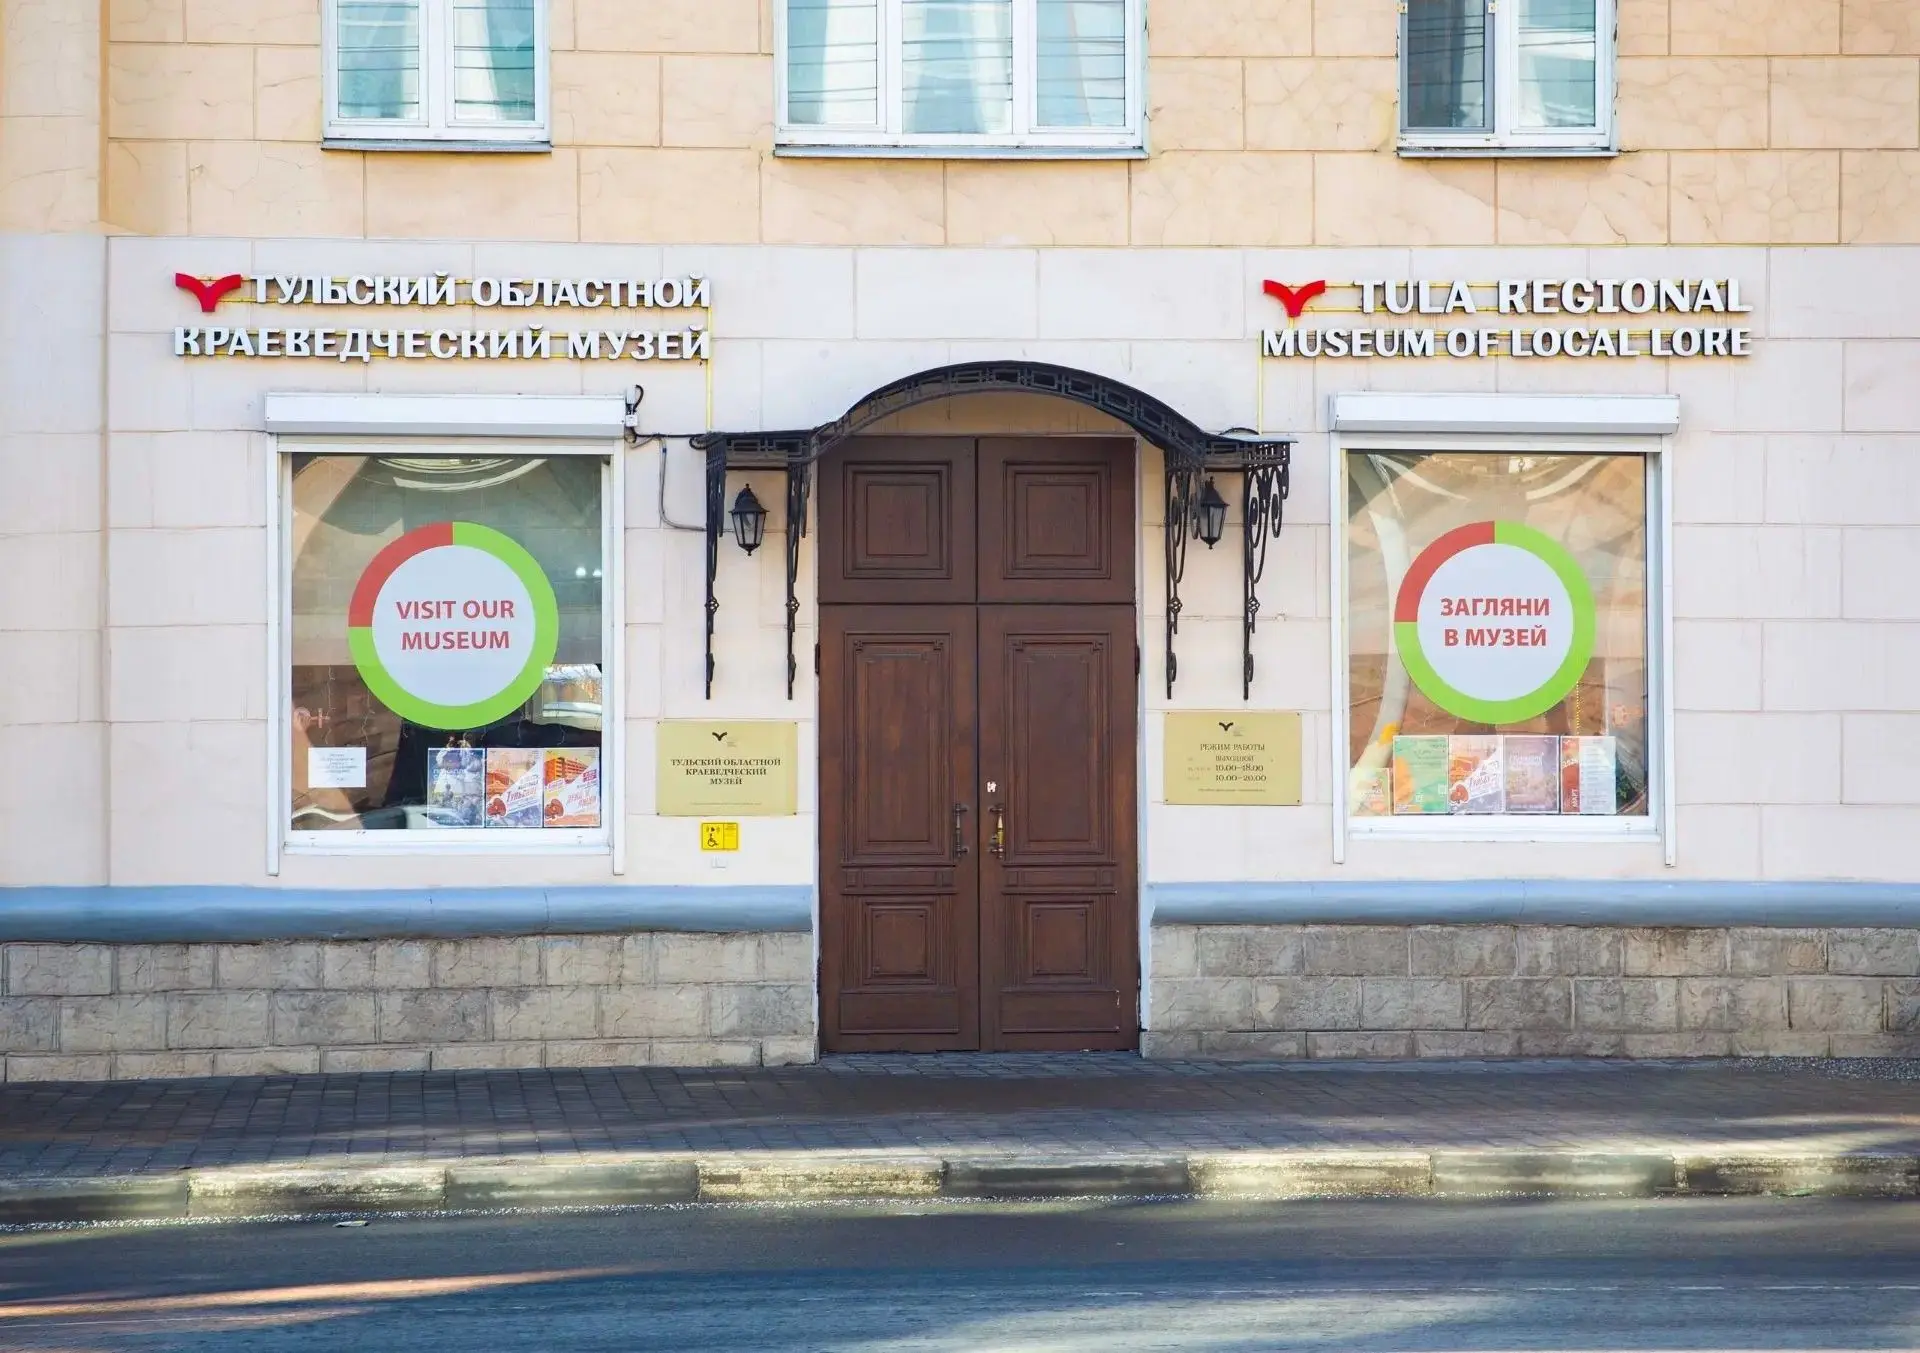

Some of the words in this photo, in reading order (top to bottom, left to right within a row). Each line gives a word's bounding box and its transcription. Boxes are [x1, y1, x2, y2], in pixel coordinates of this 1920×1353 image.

[250, 270, 456, 307] ТУЛЬСКИЙ
[471, 270, 711, 309] ОБЛАСТНОЙ
[1354, 278, 1477, 314] TULA
[1496, 277, 1754, 314] REGIONAL
[173, 323, 552, 362] КРАЕВЕДЧЕСКИЙ
[567, 323, 711, 361] МУЗЕЙ
[1262, 328, 1435, 358] MUSEUM
[1446, 327, 1499, 357] OF
[1511, 327, 1641, 358] LOCAL
[1649, 327, 1753, 357] LORE
[396, 600, 456, 620] VISIT
[462, 599, 515, 619] OUR
[1440, 597, 1550, 616] ЗАГЛЯНИ
[401, 630, 510, 650] MUSEUM
[1444, 628, 1459, 646] В
[1465, 624, 1547, 646] МУЗЕЙ
[1200, 743, 1230, 751] РЕЖИМ
[1233, 743, 1265, 751] РАБОТЫ
[671, 757, 721, 767] ТУЛЬСКИЙ
[723, 757, 781, 767] ОБЛАСТНОЙ
[686, 767, 767, 776] КРАЕВЕДЧЕСКИЙ
[710, 777, 743, 785] МУЗЕЙ
